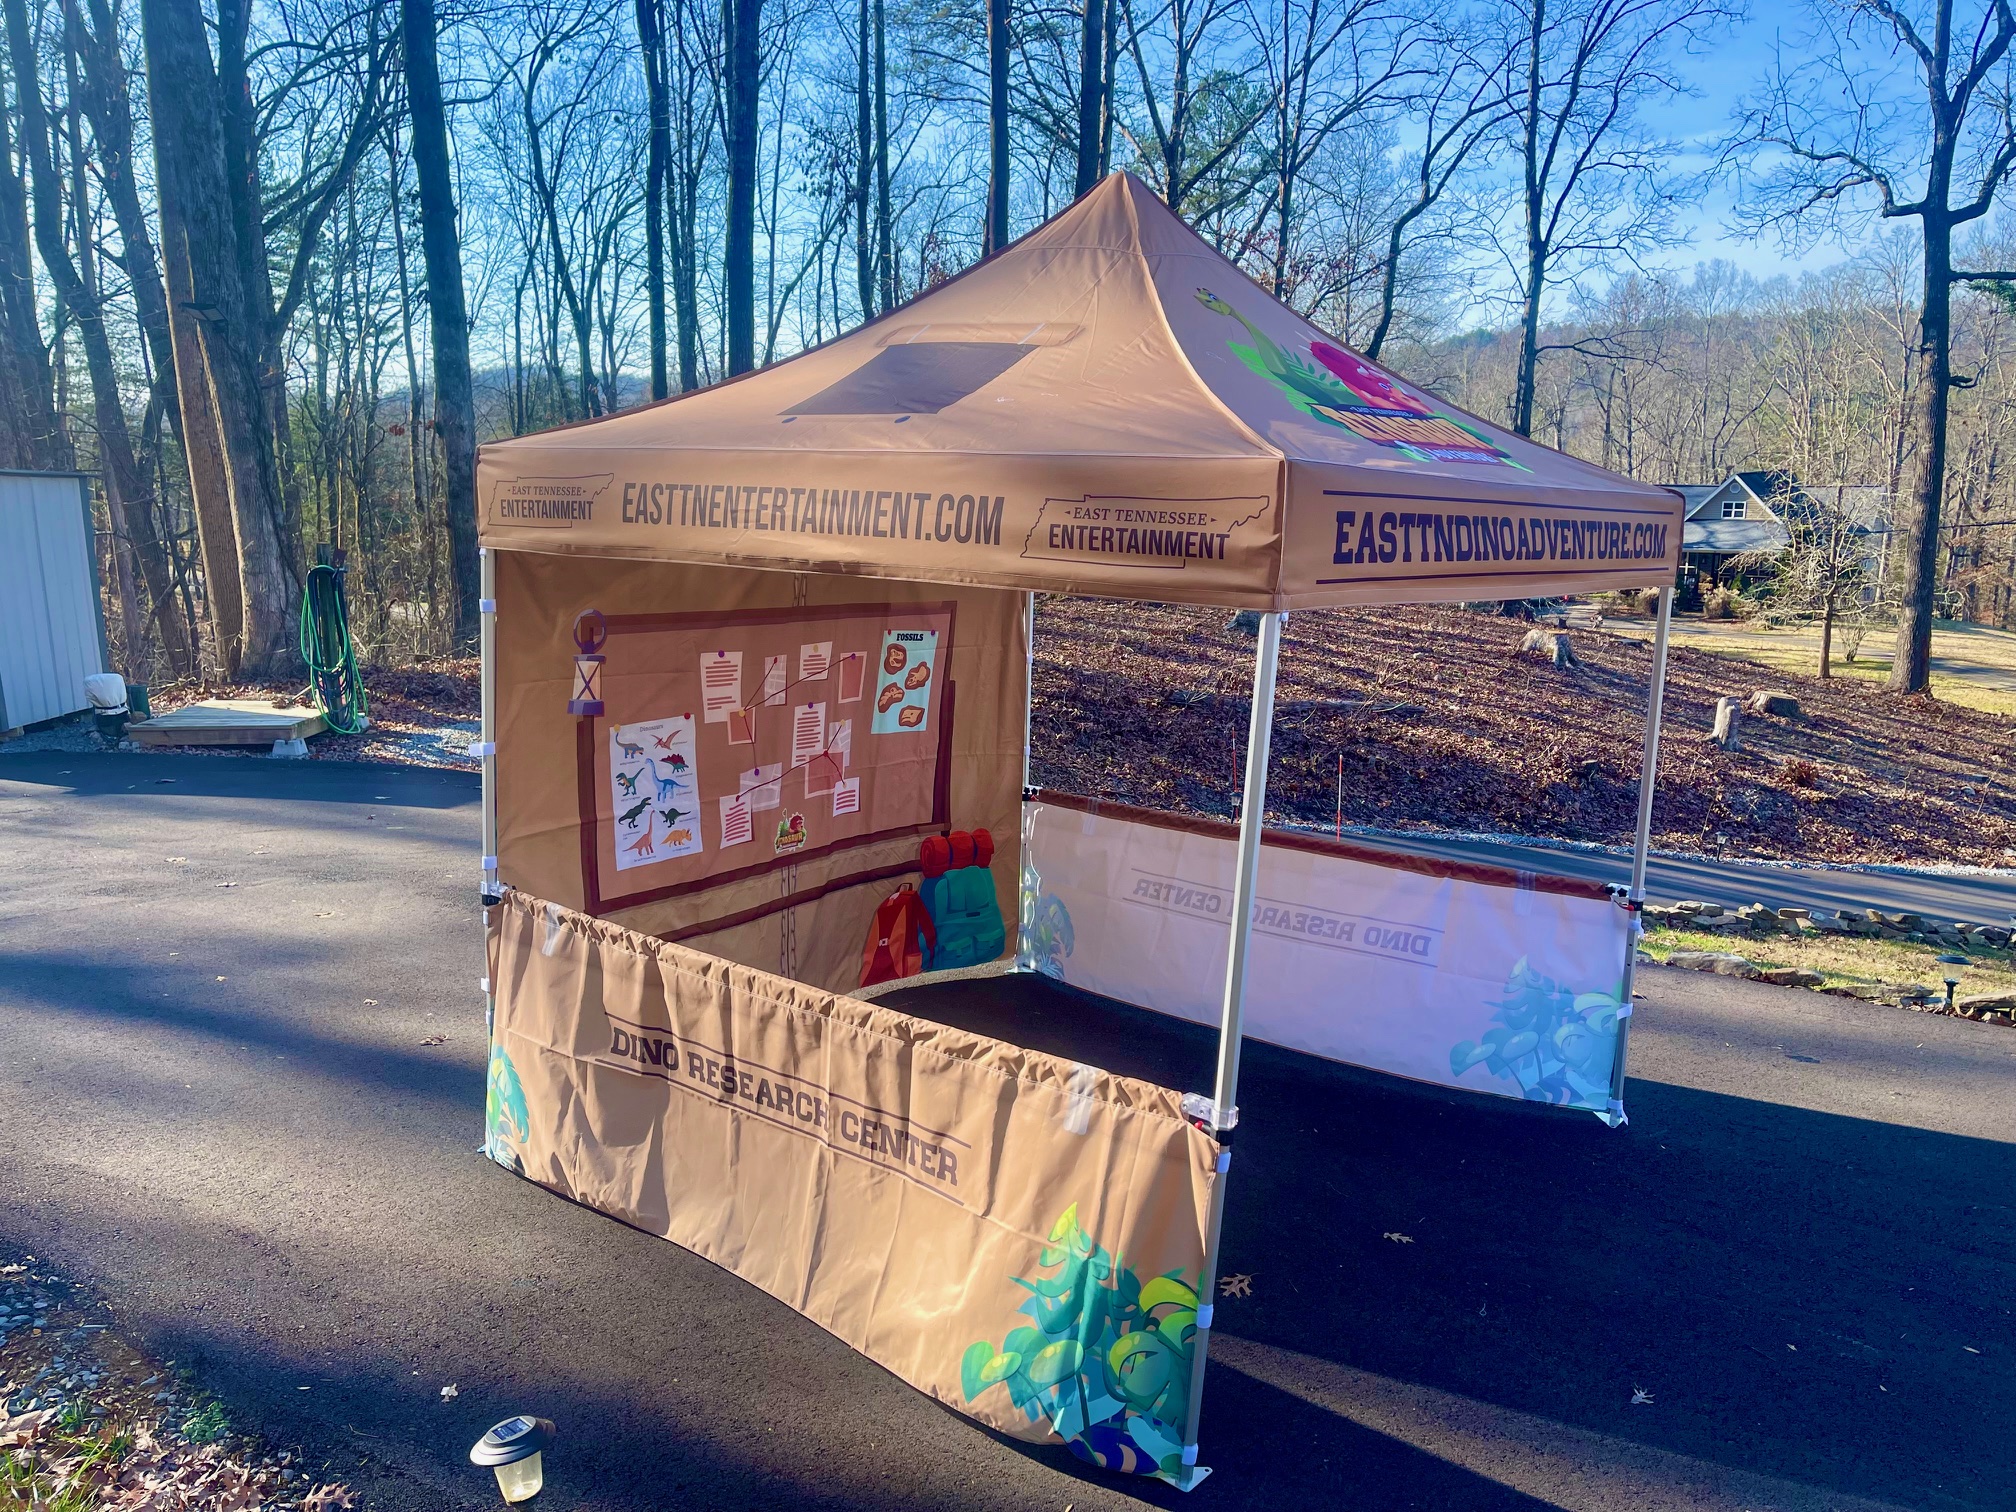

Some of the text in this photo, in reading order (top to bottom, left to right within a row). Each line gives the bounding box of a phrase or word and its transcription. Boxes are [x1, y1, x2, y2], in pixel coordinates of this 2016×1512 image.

[511, 486, 582, 496] EAST TENNESSEE
[500, 499, 594, 520] ENTERTAINMENT
[622, 482, 1005, 546] EASTTNENTERTAINMENT.COM
[1073, 507, 1208, 526] EAST TENNESSEE
[1049, 523, 1231, 560] ENTERTAINMENT
[1333, 510, 1668, 564] EASTTNDINOADVENTURE.COM
[896, 633, 924, 641] FOSSILS
[610, 1026, 959, 1186] DINO RESEARCH CENTER
